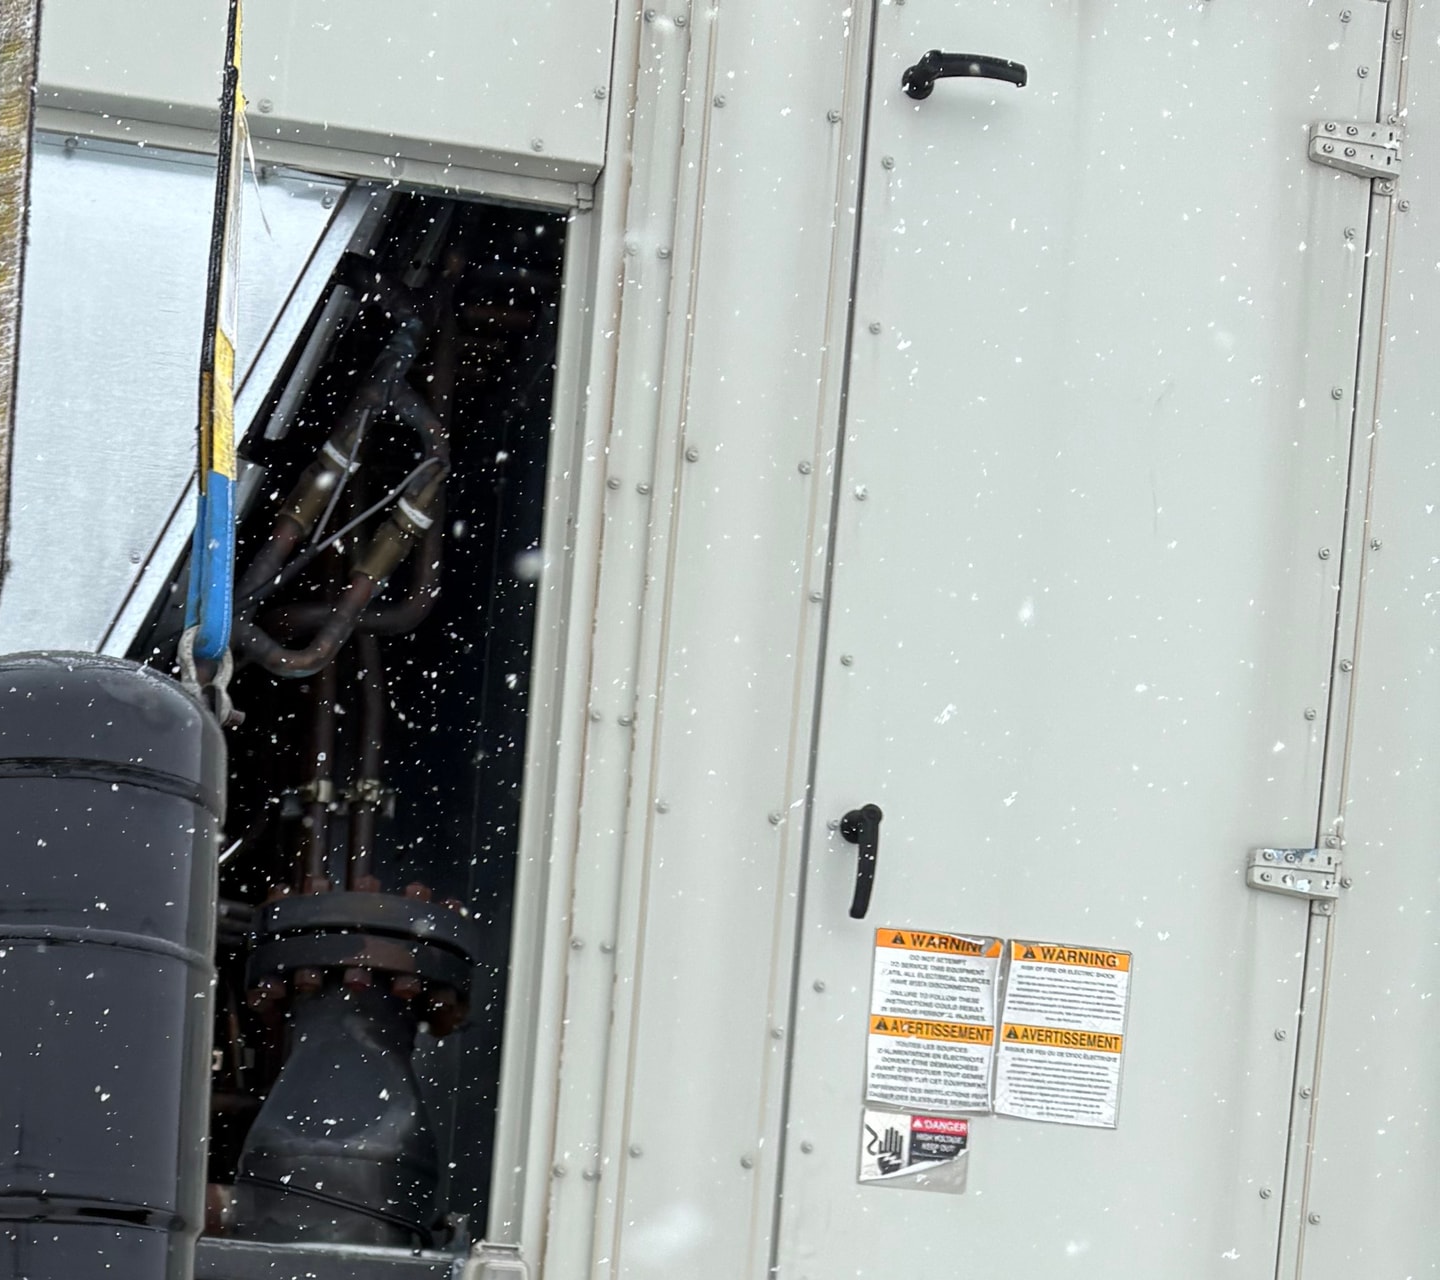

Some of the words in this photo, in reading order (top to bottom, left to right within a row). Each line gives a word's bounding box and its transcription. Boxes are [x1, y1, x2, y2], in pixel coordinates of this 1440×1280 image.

[1041, 946, 1117, 967] WARNING
[890, 1020, 993, 1041] AVERTISSEMENT
[1021, 1027, 1120, 1050] AVERTISSEMENT
[923, 1119, 966, 1132] DANGER
